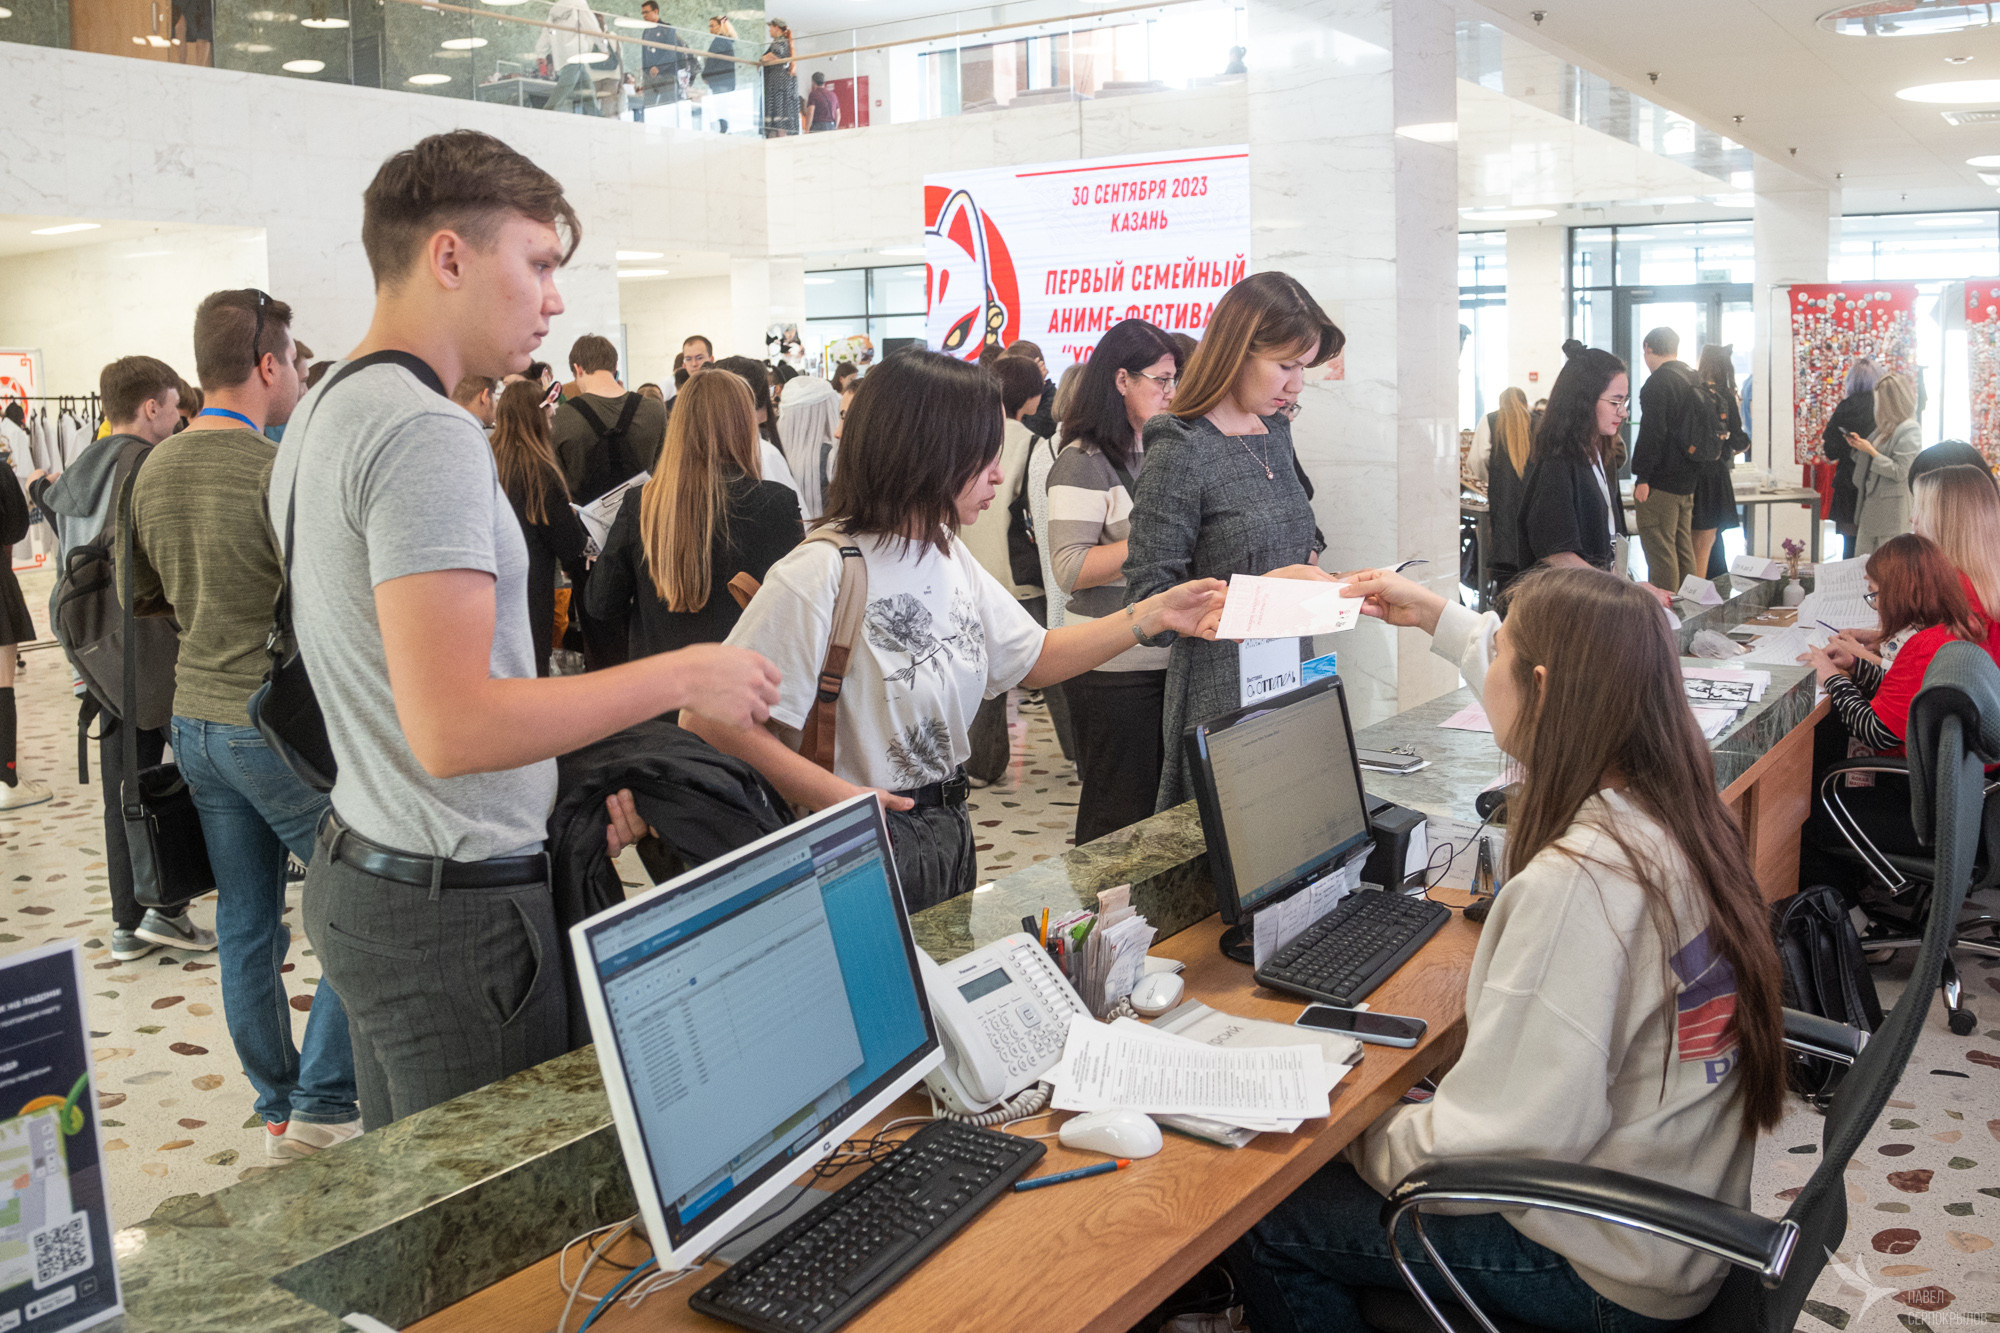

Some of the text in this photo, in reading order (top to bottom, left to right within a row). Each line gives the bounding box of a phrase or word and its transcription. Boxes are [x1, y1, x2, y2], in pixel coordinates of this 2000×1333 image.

[1072, 176, 1208, 206] 30 СЕНТЯБРЯ 2023
[1110, 210, 1168, 232] КАЗАНЬ
[1045, 253, 1245, 295] ПЕРВЫЙ СЕМЕЙНЫЙ
[1047, 302, 1214, 334] АНИМЕ-ФЕСТИВА
